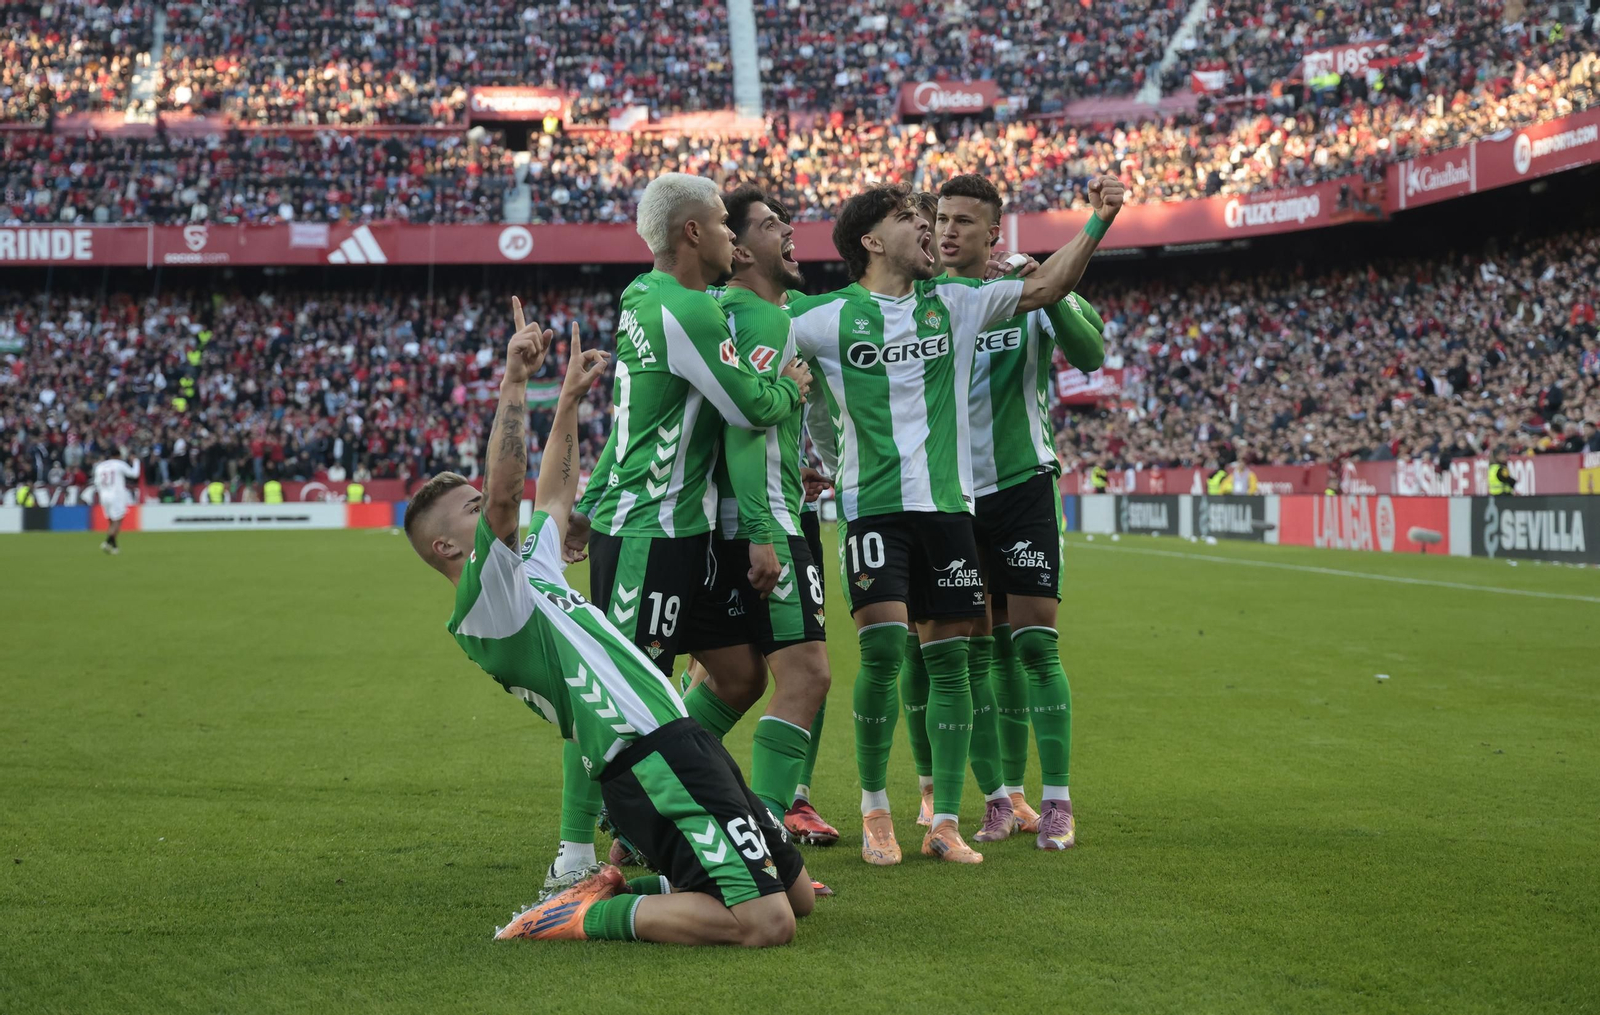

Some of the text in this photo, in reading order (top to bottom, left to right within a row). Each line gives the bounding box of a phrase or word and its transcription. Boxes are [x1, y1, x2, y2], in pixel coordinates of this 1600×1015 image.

[1224, 194, 1320, 228] Cruzcampo
[0, 229, 93, 260] RINDE
[882, 335, 948, 363] GREE
[975, 329, 1019, 352] REE
[1129, 502, 1168, 529] SEVILLA
[1209, 503, 1253, 533] SEVILLA
[1313, 495, 1374, 551] LALIGA
[1501, 509, 1586, 552] SEVILLA
[848, 532, 885, 574] 10
[1020, 551, 1045, 560] AUS
[806, 565, 824, 605] 8
[938, 578, 983, 587] GLOBAL
[956, 569, 978, 578] AUS
[648, 591, 681, 638] 19
[905, 703, 926, 711] BET
[973, 704, 991, 715] TIS
[1034, 703, 1067, 712] BETIS
